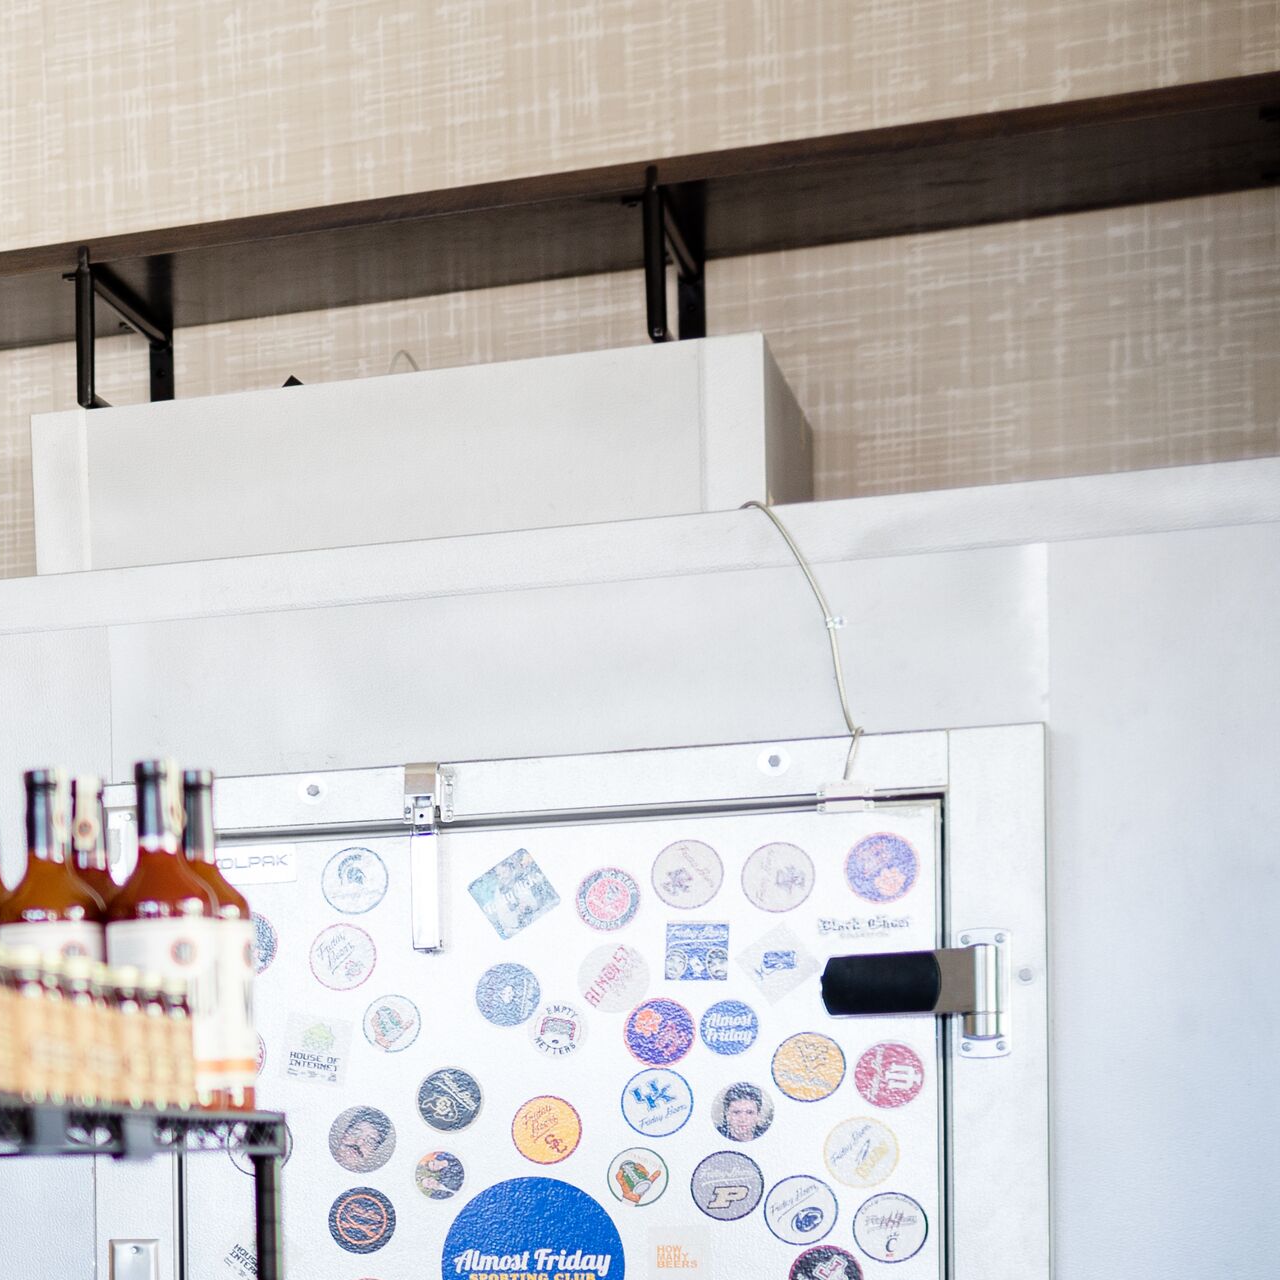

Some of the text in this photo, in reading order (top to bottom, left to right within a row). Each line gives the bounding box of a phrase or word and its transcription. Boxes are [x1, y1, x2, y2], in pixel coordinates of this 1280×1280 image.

[214, 852, 288, 870] OLPAK
[706, 1012, 752, 1027] Almost
[705, 1027, 752, 1042] Friday
[289, 1050, 322, 1063] HOUSE
[656, 1245, 682, 1253] HOW
[453, 1248, 611, 1277] Almost Friday
[656, 1253, 689, 1261] MANY
[656, 1260, 698, 1269] BEERS
